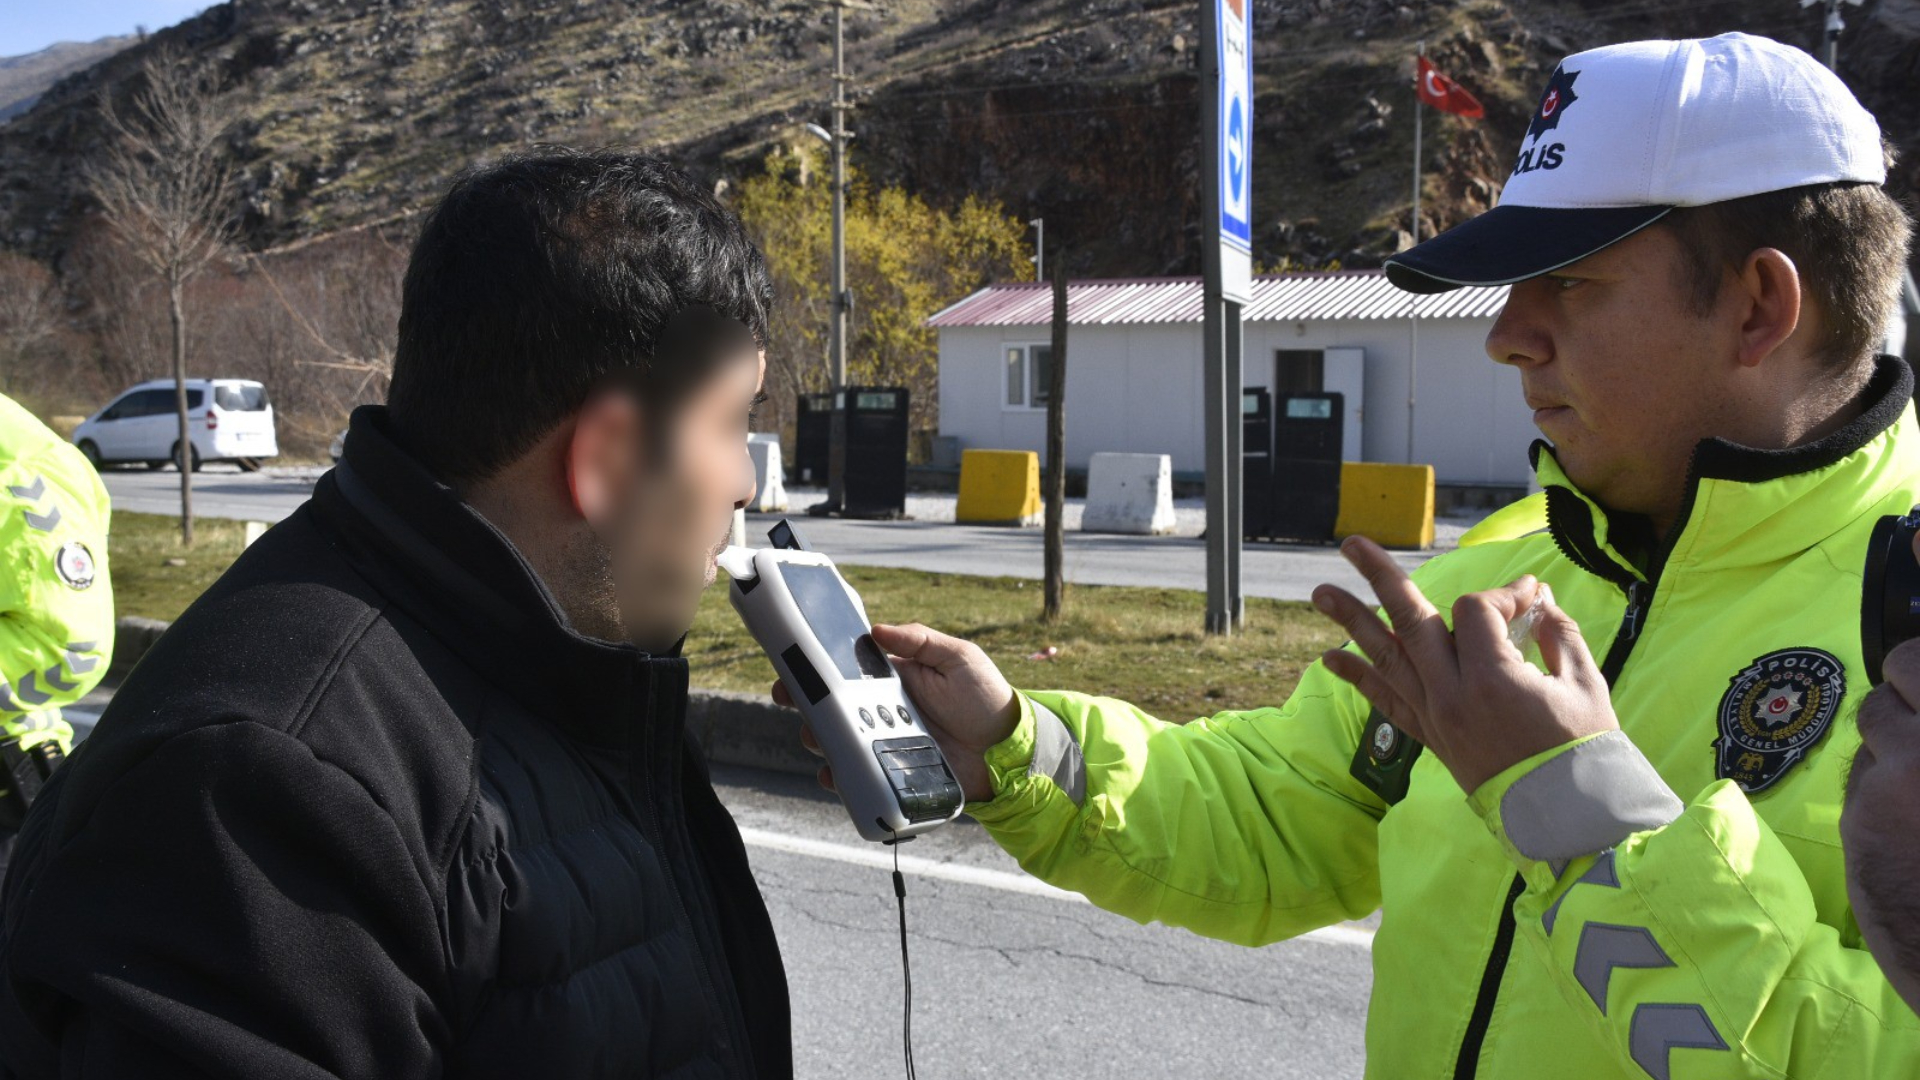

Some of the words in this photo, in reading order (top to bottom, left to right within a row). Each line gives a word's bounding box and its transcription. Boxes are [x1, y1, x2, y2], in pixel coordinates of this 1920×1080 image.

[1513, 143, 1566, 176] OLİS
[1768, 657, 1830, 677] POLİS
[1740, 734, 1780, 749] GENEL
